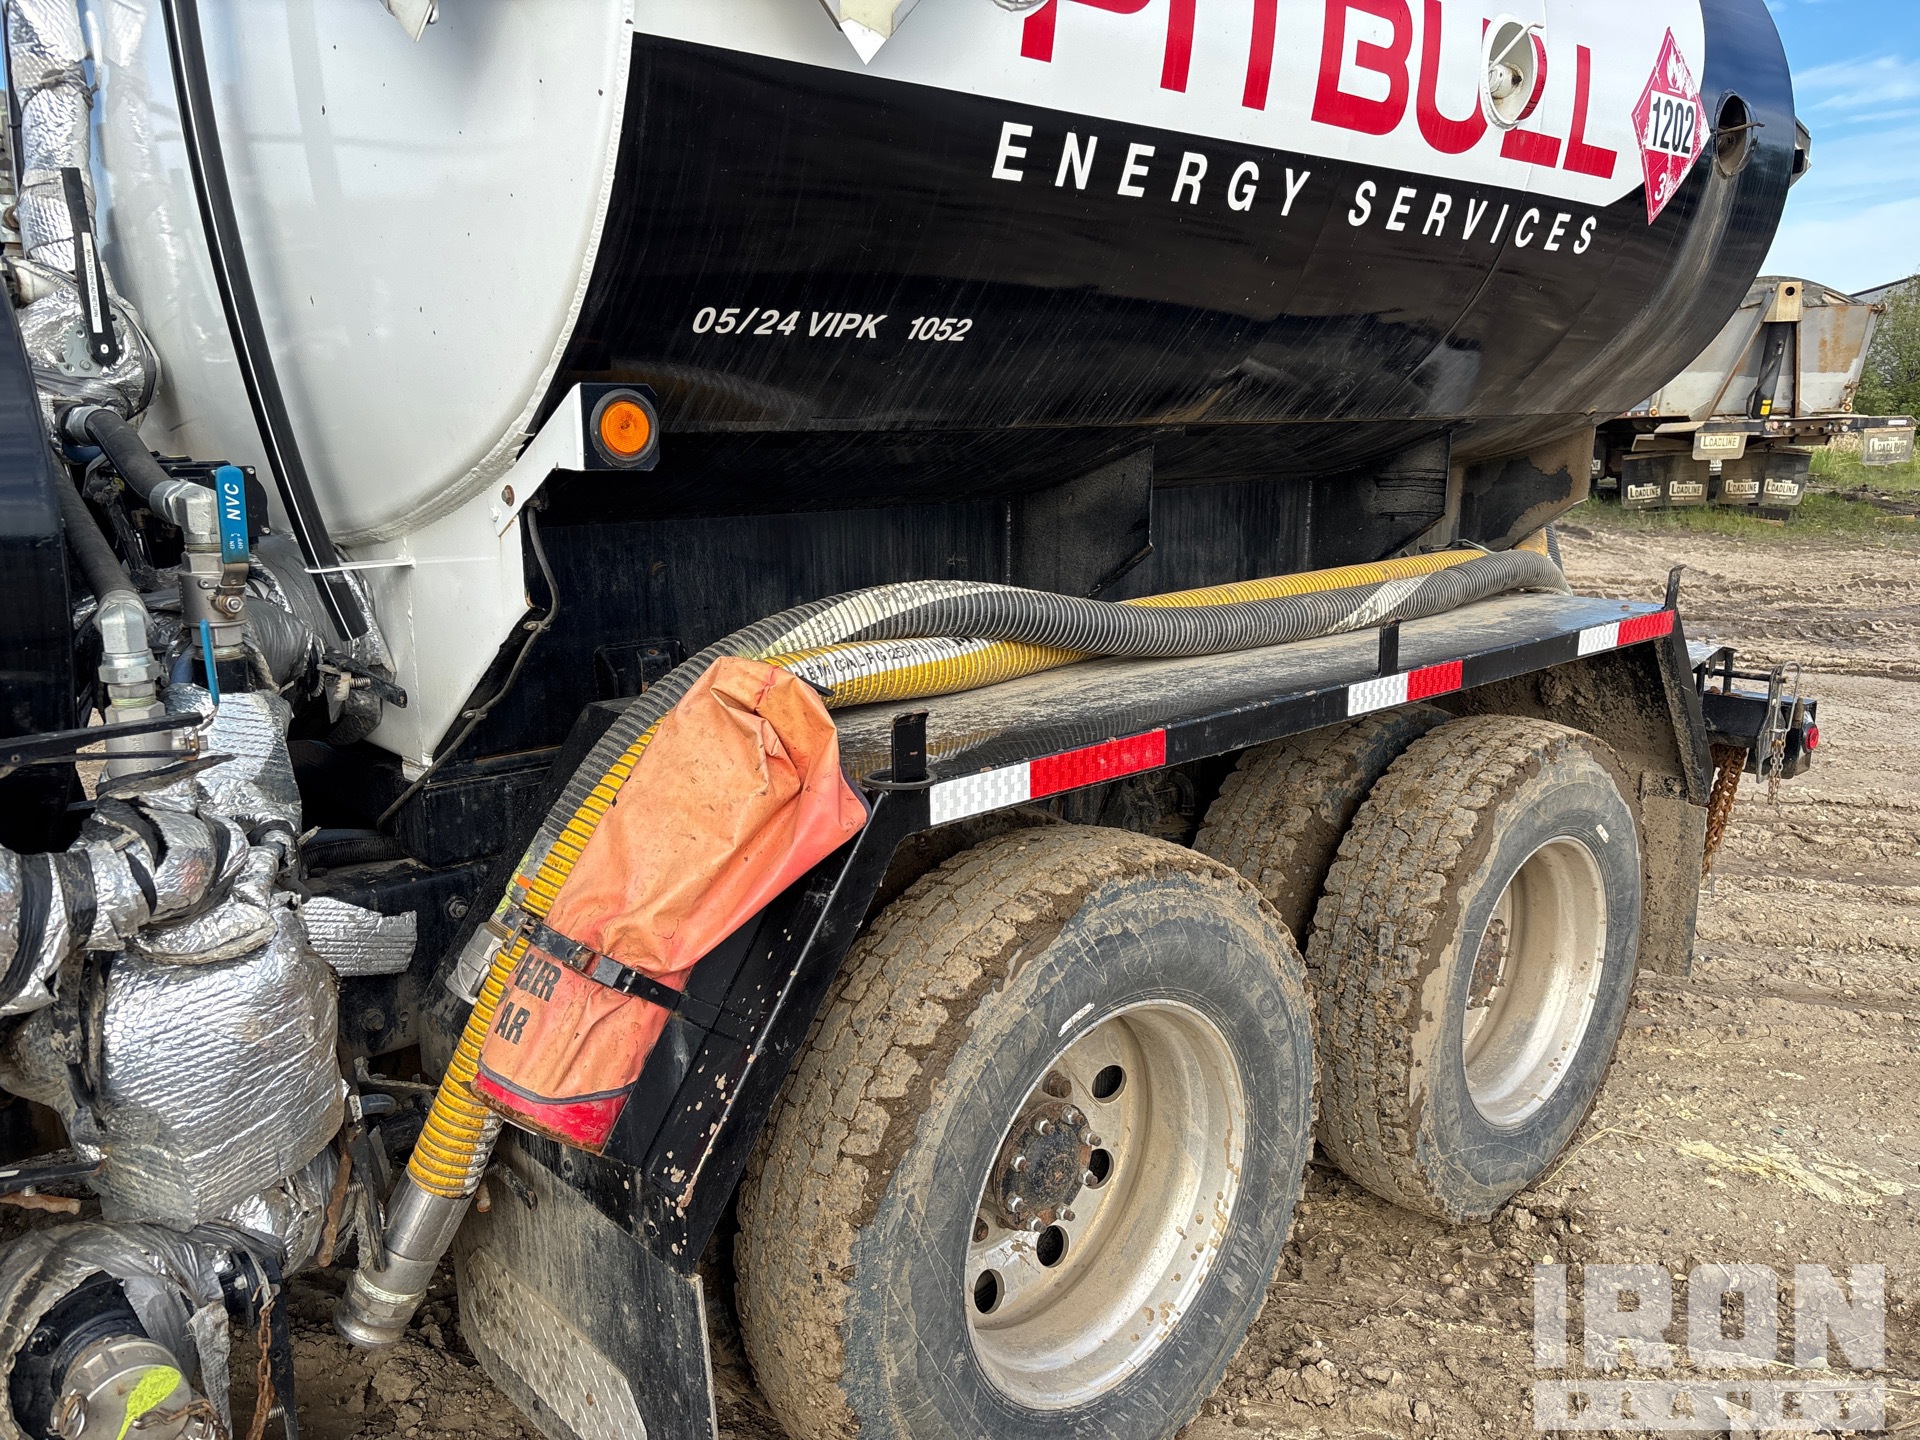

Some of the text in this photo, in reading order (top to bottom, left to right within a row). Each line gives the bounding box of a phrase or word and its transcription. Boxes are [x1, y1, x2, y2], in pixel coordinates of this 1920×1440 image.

[1651, 96, 1696, 155] 1202
[991, 121, 1597, 255] ENERGY SERVICES
[1654, 172, 1668, 201] 3
[88, 263, 97, 295] OVERHEAD
[91, 295, 99, 318] RETURN
[692, 307, 973, 342] 05/24 VIPK 1052
[1702, 435, 1737, 447] LOADLINE
[1629, 487, 1659, 498] LOADLINE
[1671, 483, 1701, 494] LOADLINE
[1727, 481, 1757, 493] LOADLINE
[1765, 480, 1797, 494] LOADLINE
[224, 483, 241, 520] NVC
[229, 540, 236, 549] ON
